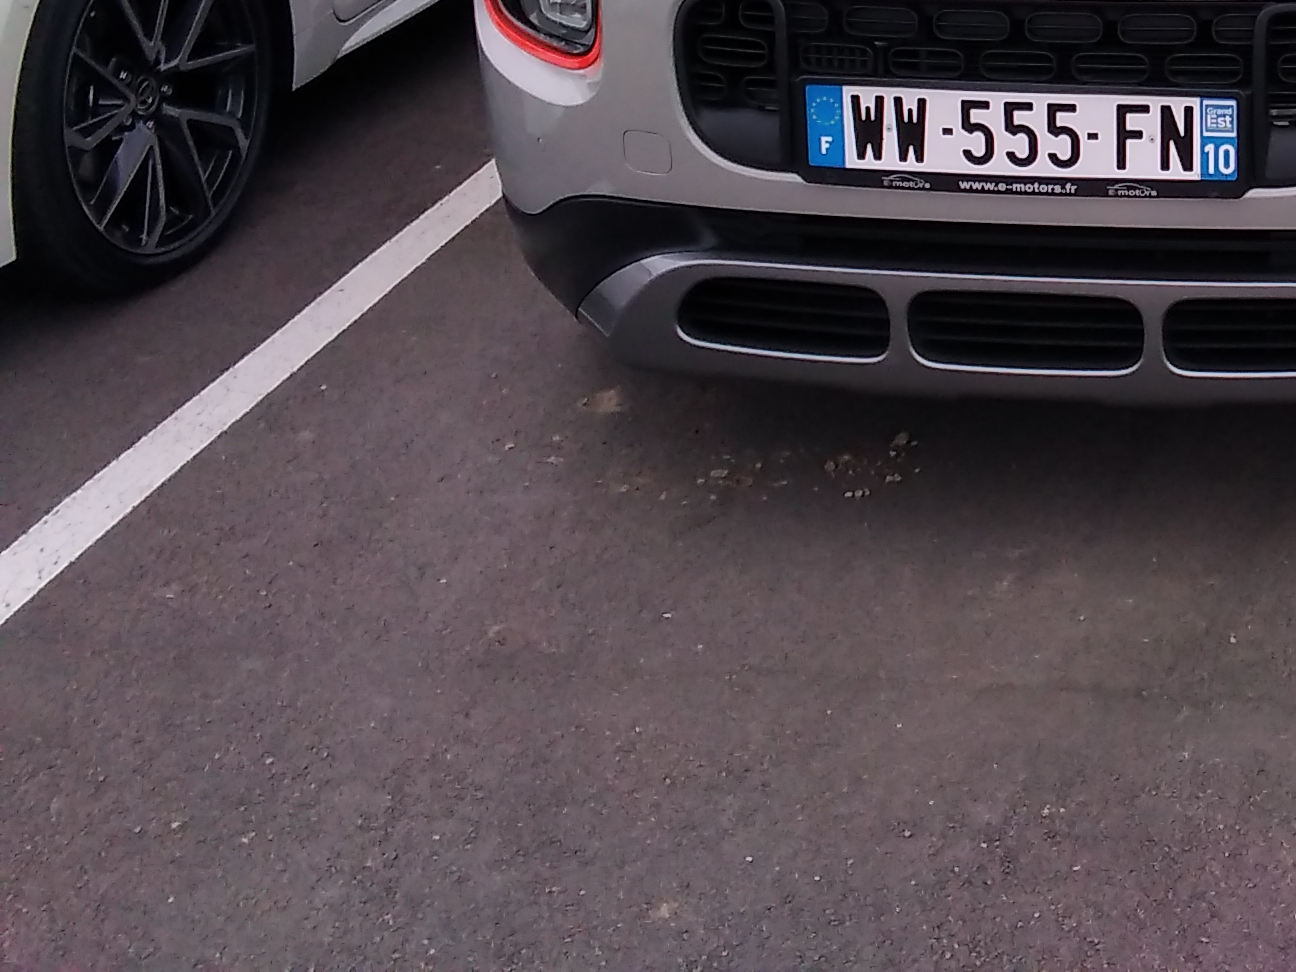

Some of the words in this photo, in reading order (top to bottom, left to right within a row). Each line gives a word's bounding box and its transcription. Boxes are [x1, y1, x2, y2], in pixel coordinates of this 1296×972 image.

[1206, 107, 1233, 115] Grand
[1206, 114, 1232, 128] Est
[819, 136, 832, 155] F
[1204, 143, 1236, 175] 10
[958, 179, 1078, 194] www.e-motors.fr
